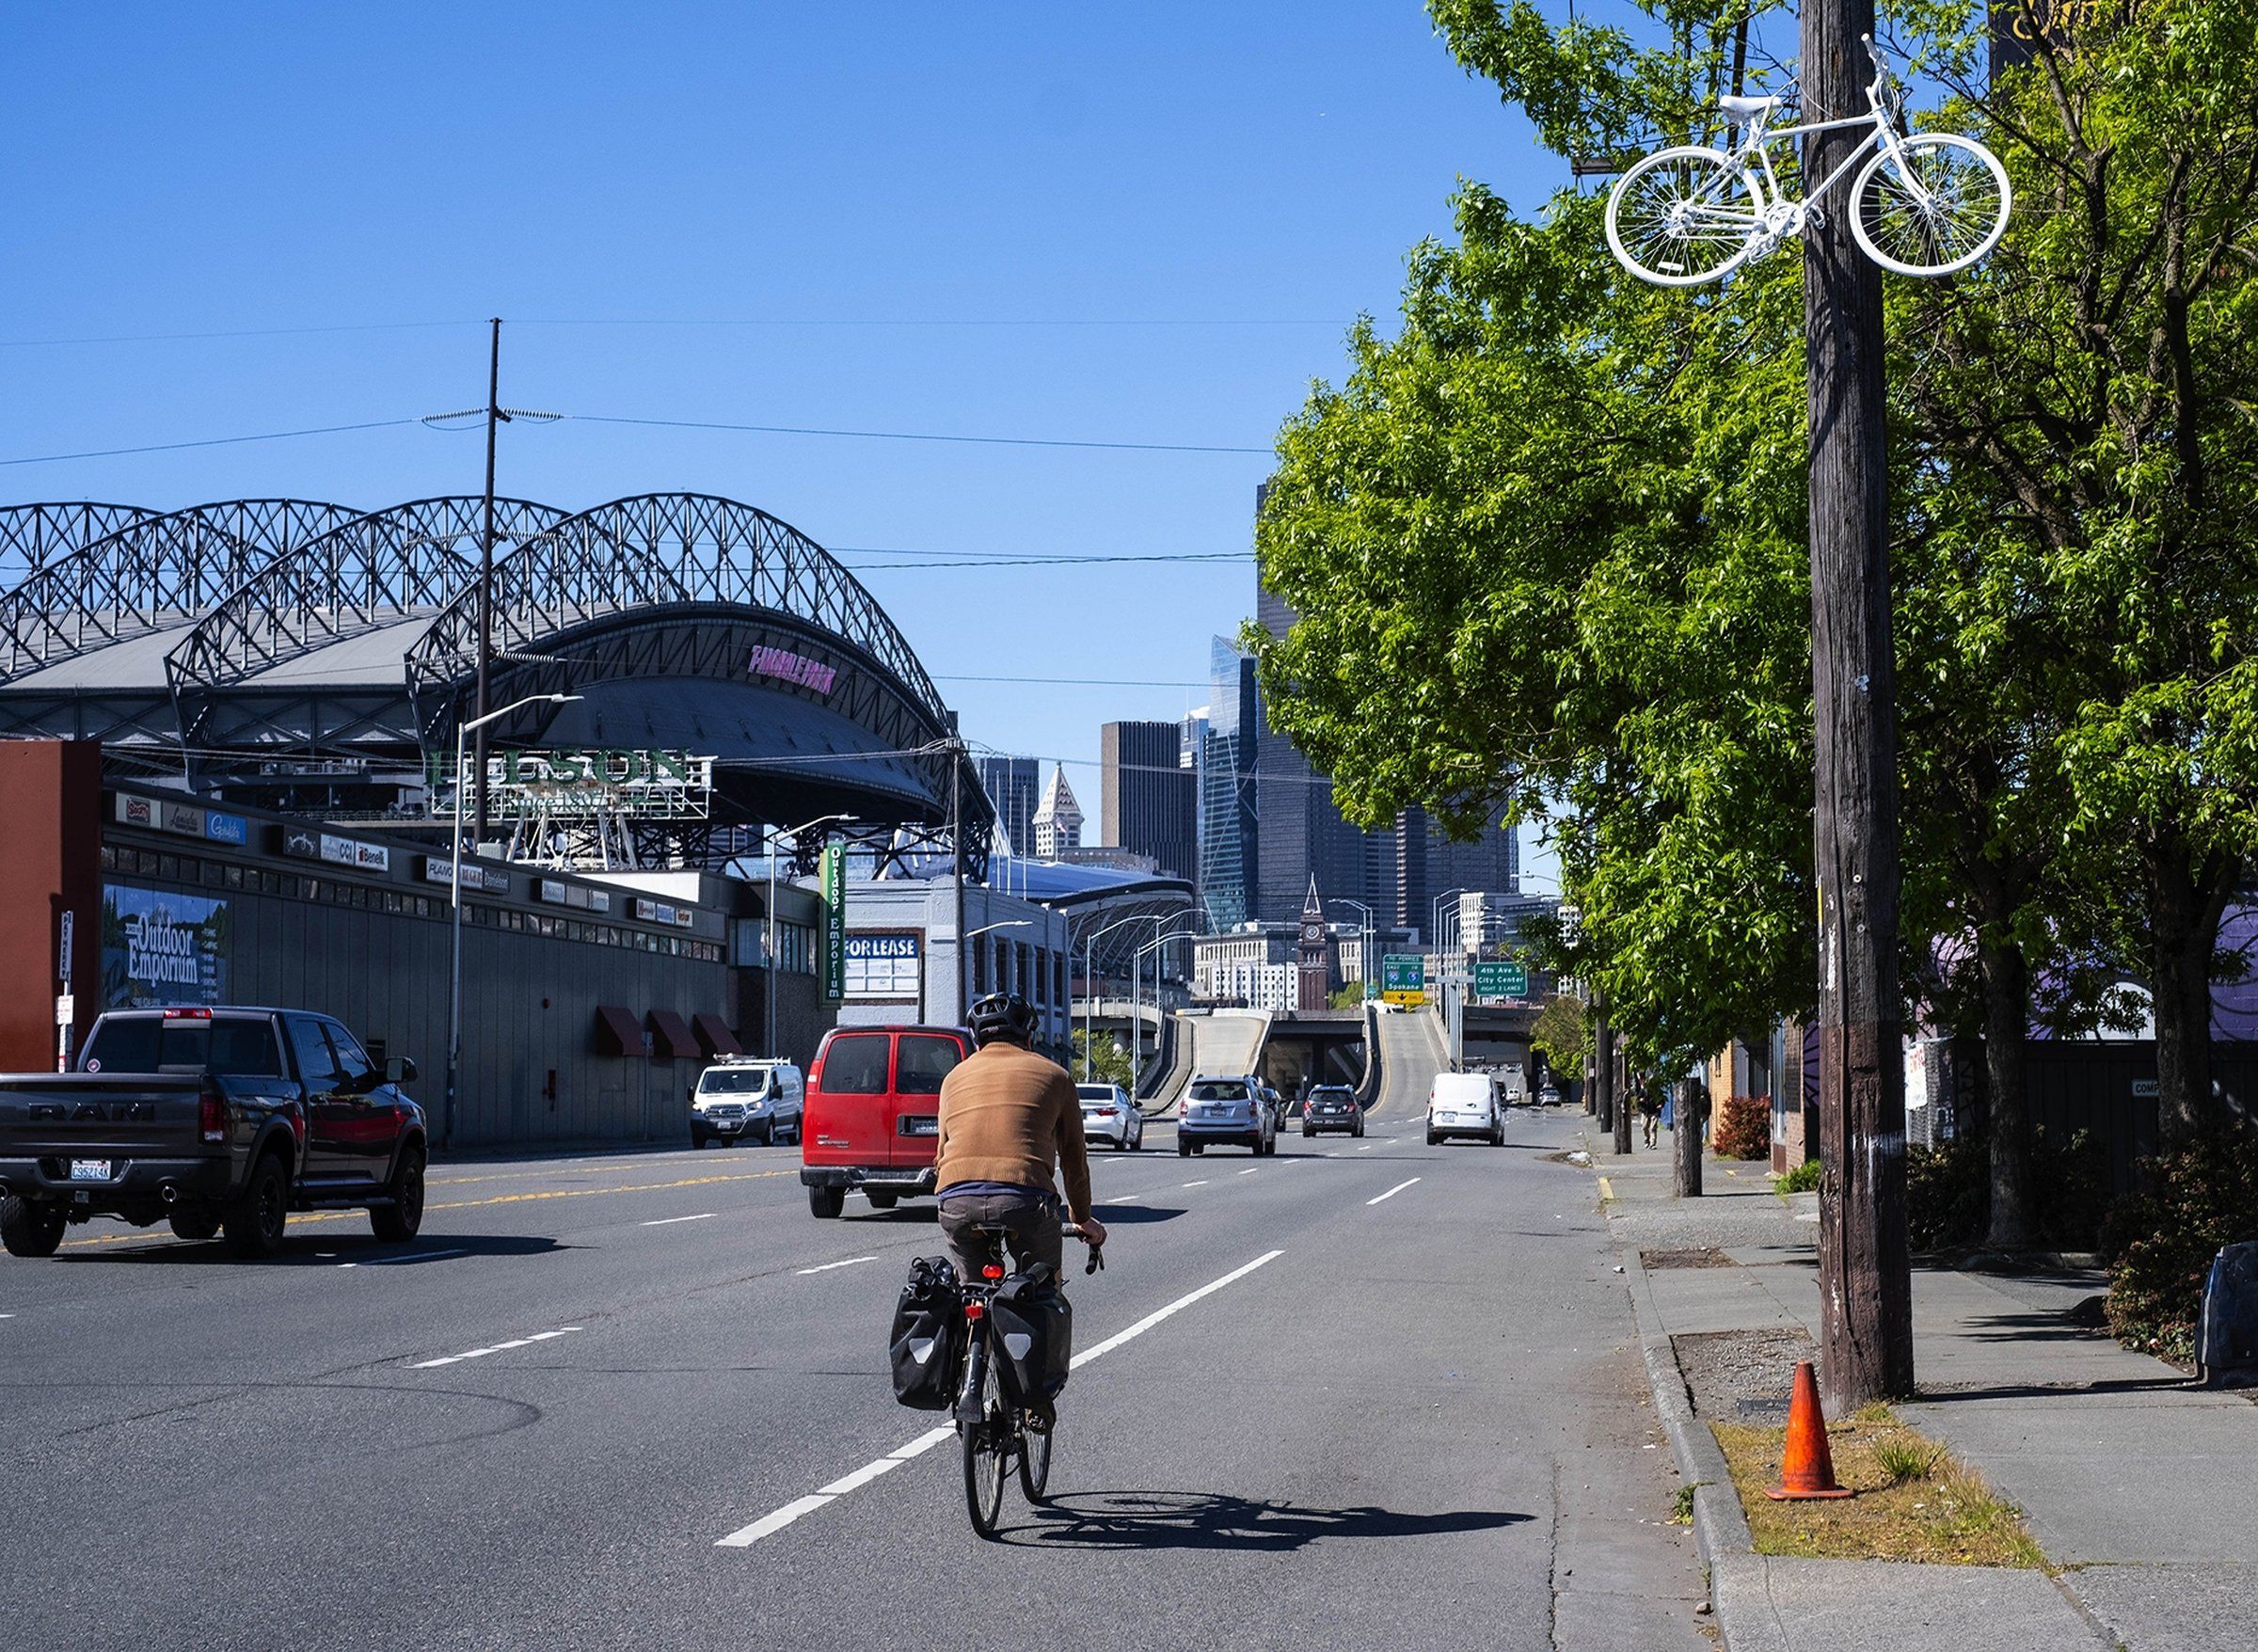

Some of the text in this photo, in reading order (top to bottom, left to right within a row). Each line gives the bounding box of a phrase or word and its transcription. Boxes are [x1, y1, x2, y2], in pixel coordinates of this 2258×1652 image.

[831, 847, 841, 913] Outdoor
[136, 911, 194, 956] Outdoor
[872, 940, 915, 957] LEASE
[127, 938, 199, 989] Emporium
[829, 917, 840, 998] Emporium
[1388, 983, 1420, 992] Spokane
[1477, 977, 1495, 985] City
[29, 1103, 155, 1121] RAM
